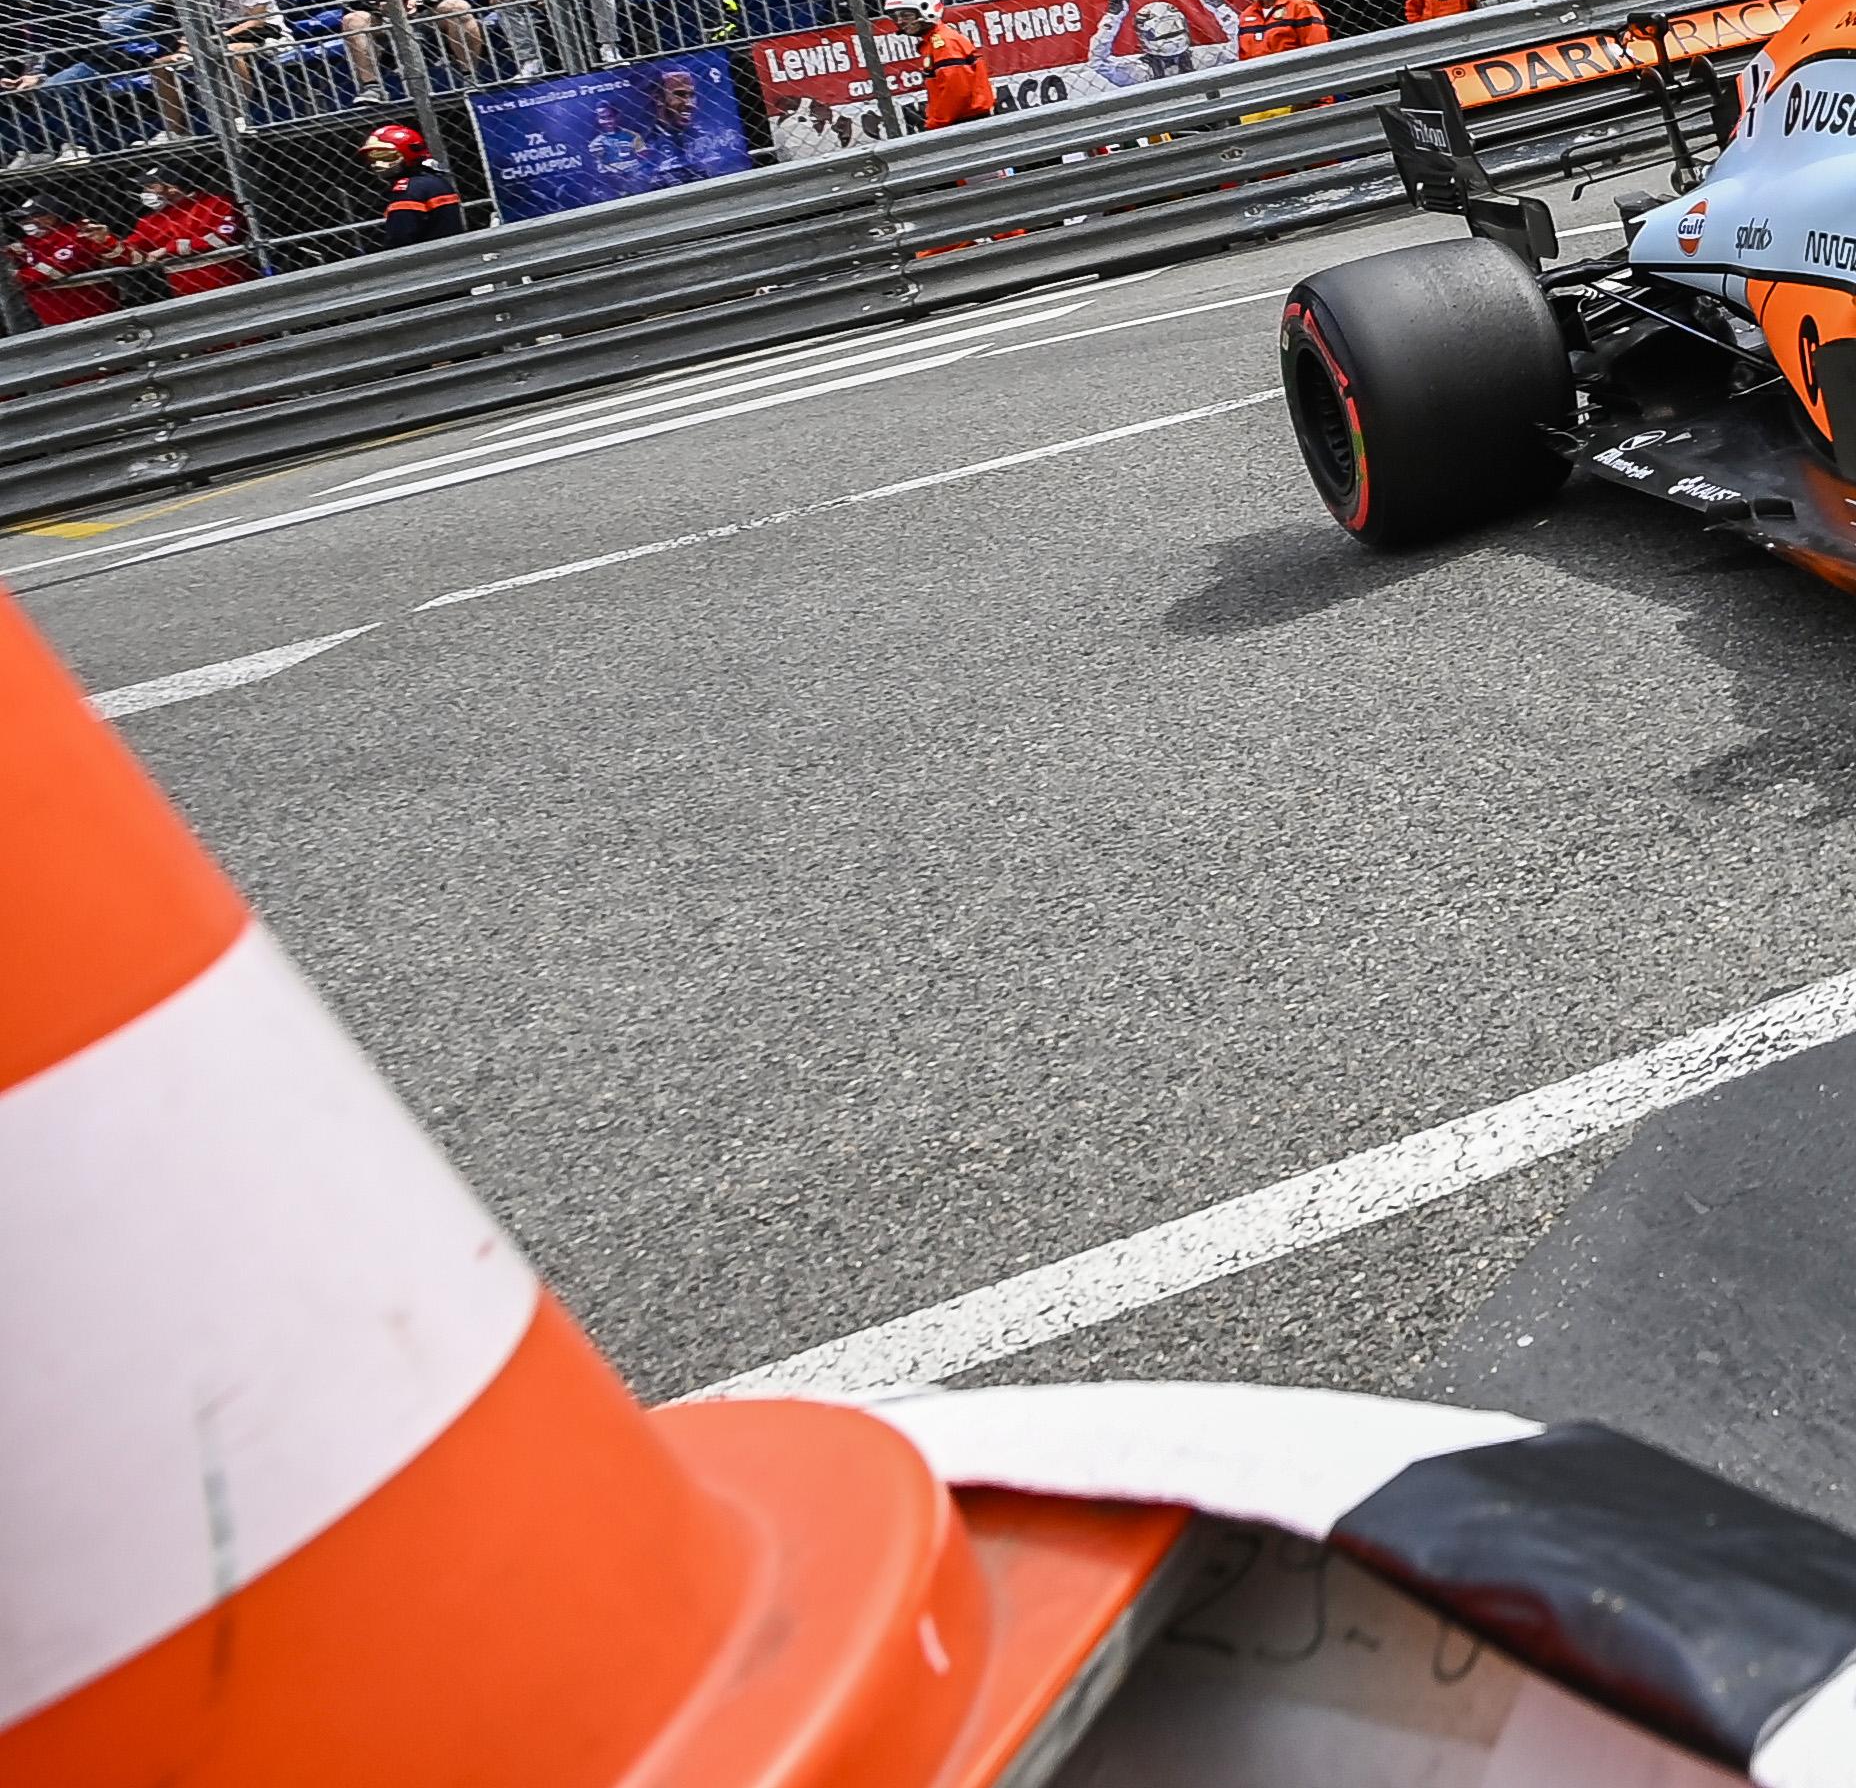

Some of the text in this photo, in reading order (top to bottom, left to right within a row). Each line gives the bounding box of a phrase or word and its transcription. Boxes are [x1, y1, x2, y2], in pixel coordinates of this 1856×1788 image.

[764, 39, 851, 84] Lewis
[984, 1, 1083, 46] France
[848, 74, 898, 97] avc
[510, 142, 568, 163] WORLD
[501, 154, 583, 180] CHAMPION
[1677, 217, 1704, 235] Gulf
